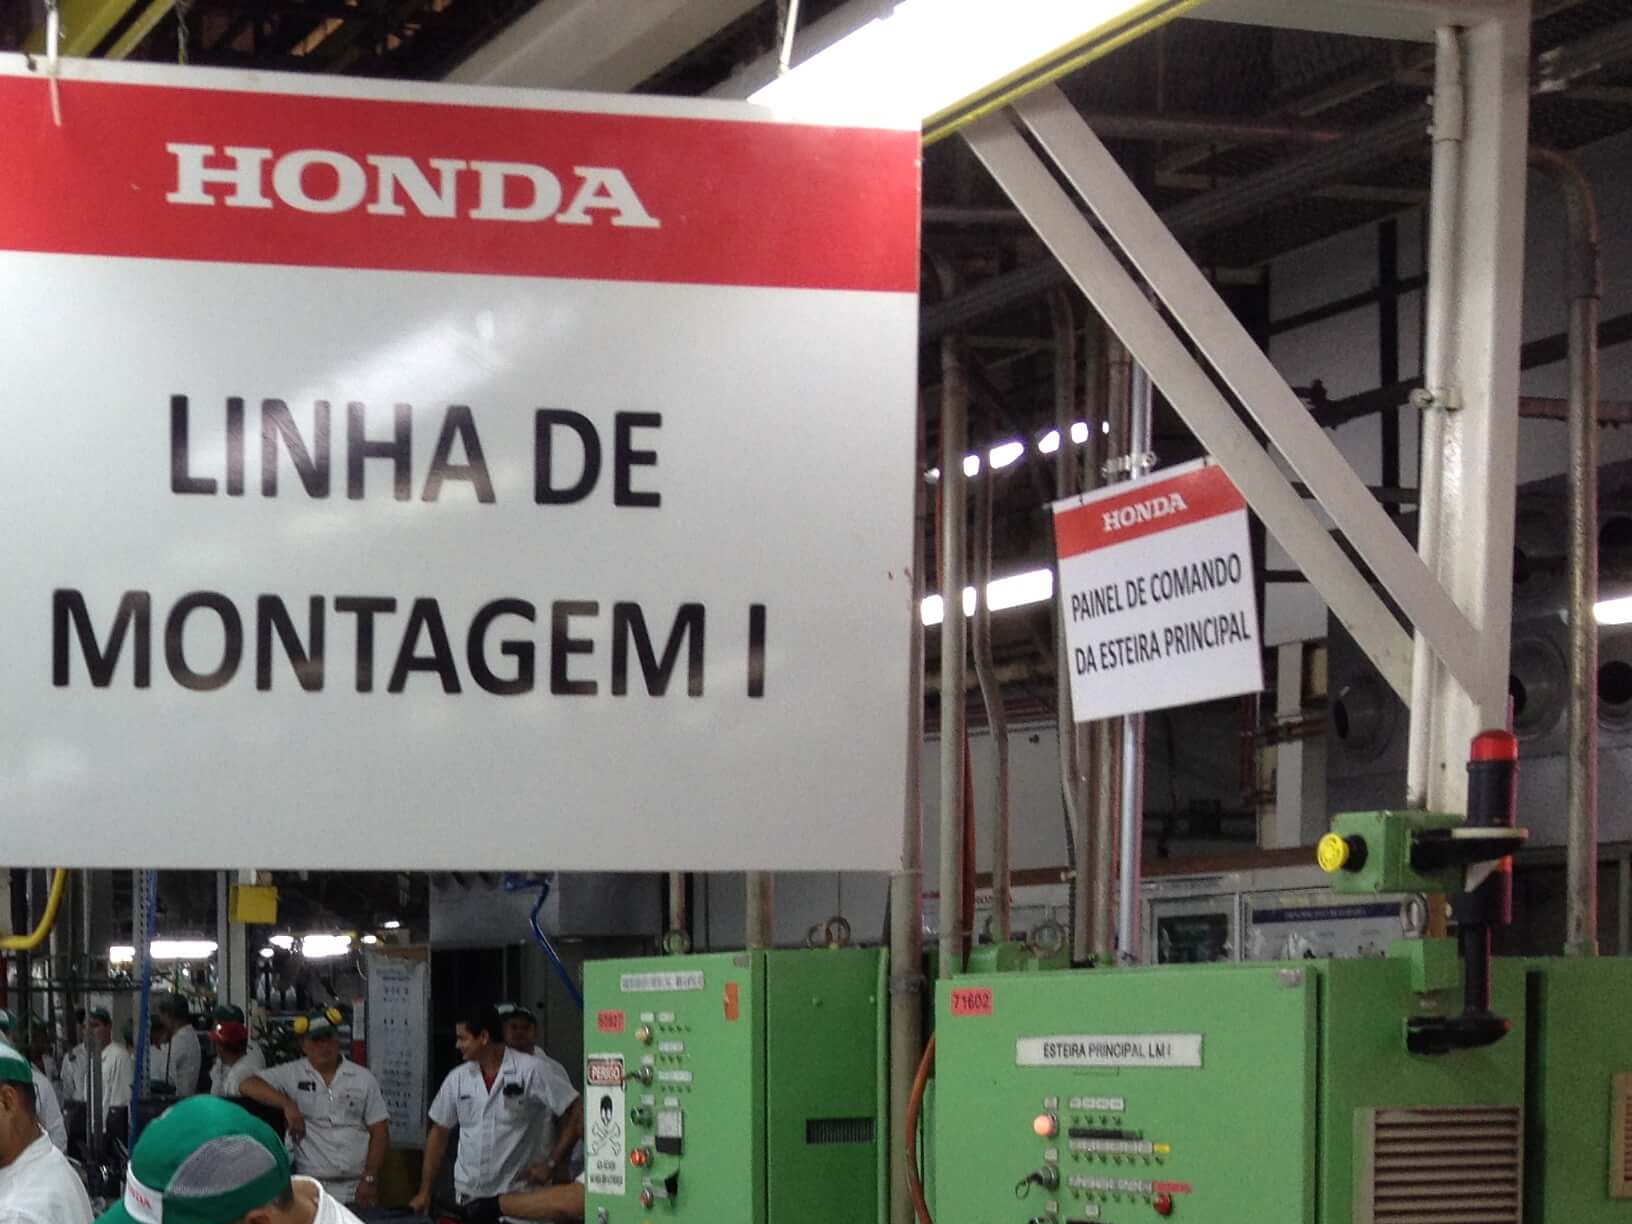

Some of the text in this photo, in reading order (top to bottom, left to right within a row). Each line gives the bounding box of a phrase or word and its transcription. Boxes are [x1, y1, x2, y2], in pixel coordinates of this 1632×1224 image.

[165, 142, 662, 230] HONDA
[169, 394, 663, 509] LINHA DE
[1101, 492, 1187, 532] HONDA
[1071, 553, 1241, 622] PAINEL DE COMANDO
[51, 588, 766, 700] MONTAGEM I
[1074, 611, 1251, 676] DA ESTEIRA PRINCIPAL
[1043, 1042, 1087, 1059] ESTEIRA
[1088, 1042, 1146, 1058] PRINCIPAL
